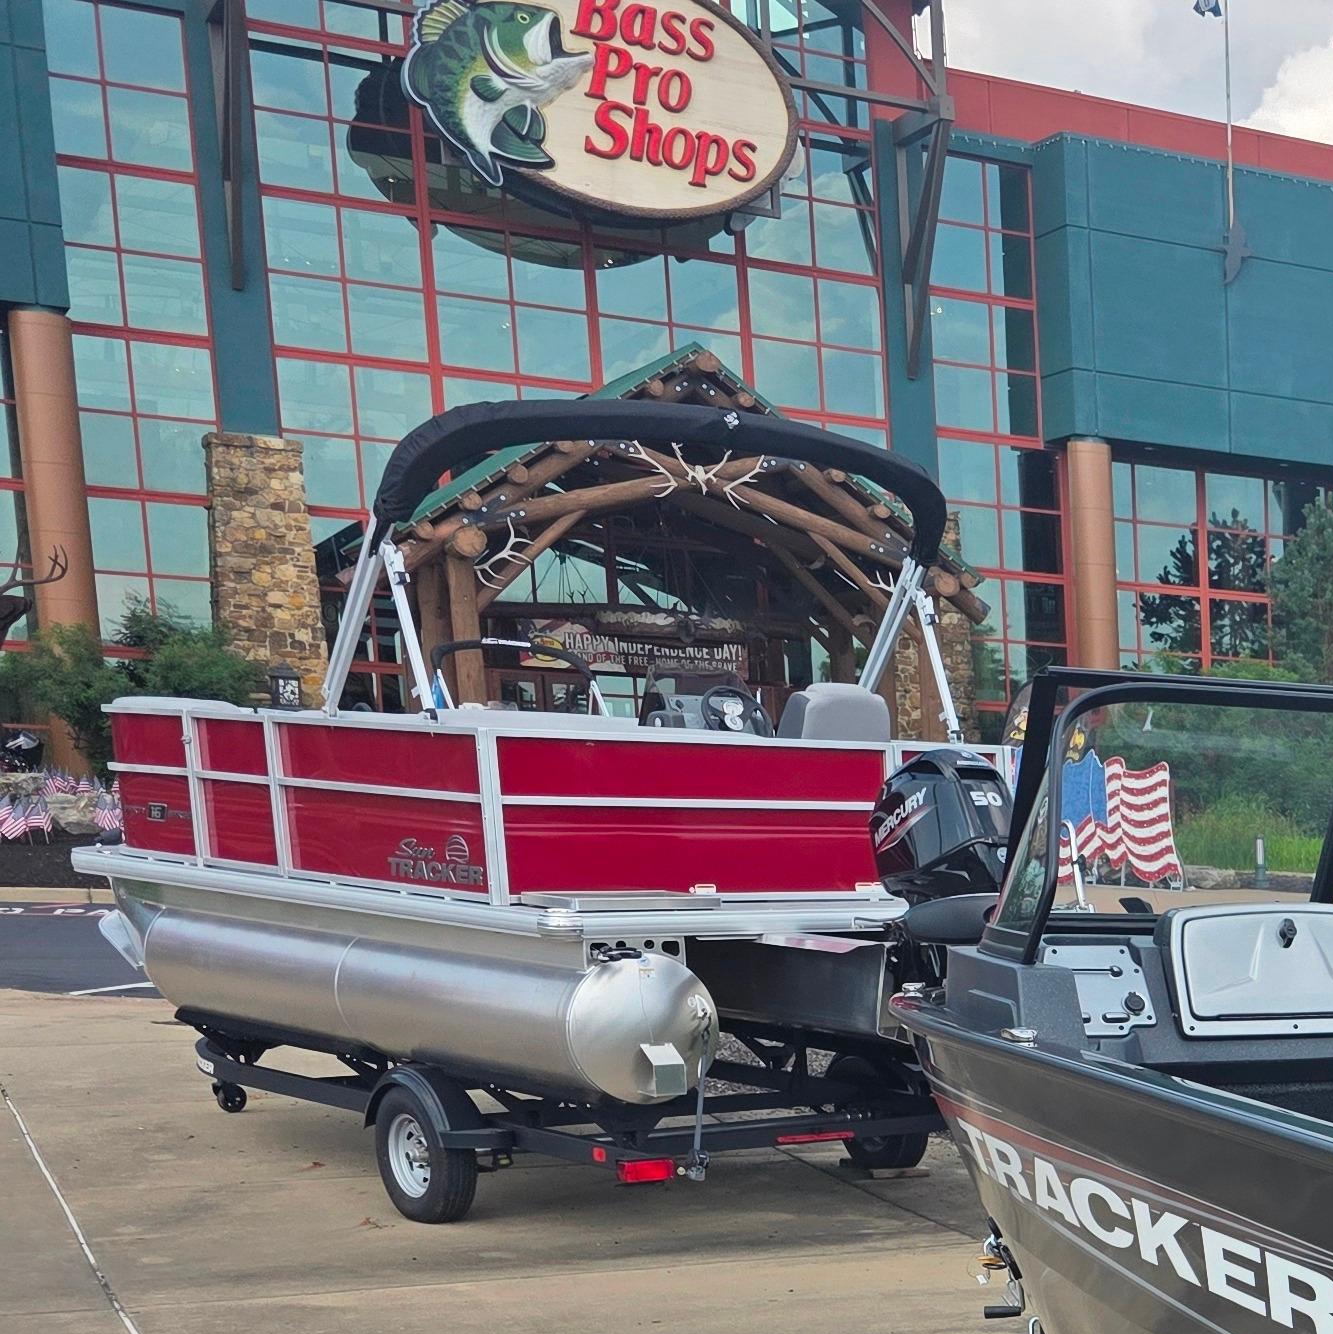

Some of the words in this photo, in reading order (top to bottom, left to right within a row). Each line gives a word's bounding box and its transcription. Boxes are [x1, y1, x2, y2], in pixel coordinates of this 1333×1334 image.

[570, 0, 715, 62] Bass
[584, 41, 692, 113] Pro
[584, 100, 757, 187] Shops
[564, 631, 611, 651] HAPPY
[609, 653, 626, 665] THE
[874, 787, 927, 849] MERCURY
[970, 791, 1003, 807] 50
[387, 857, 484, 886] TRACKER
